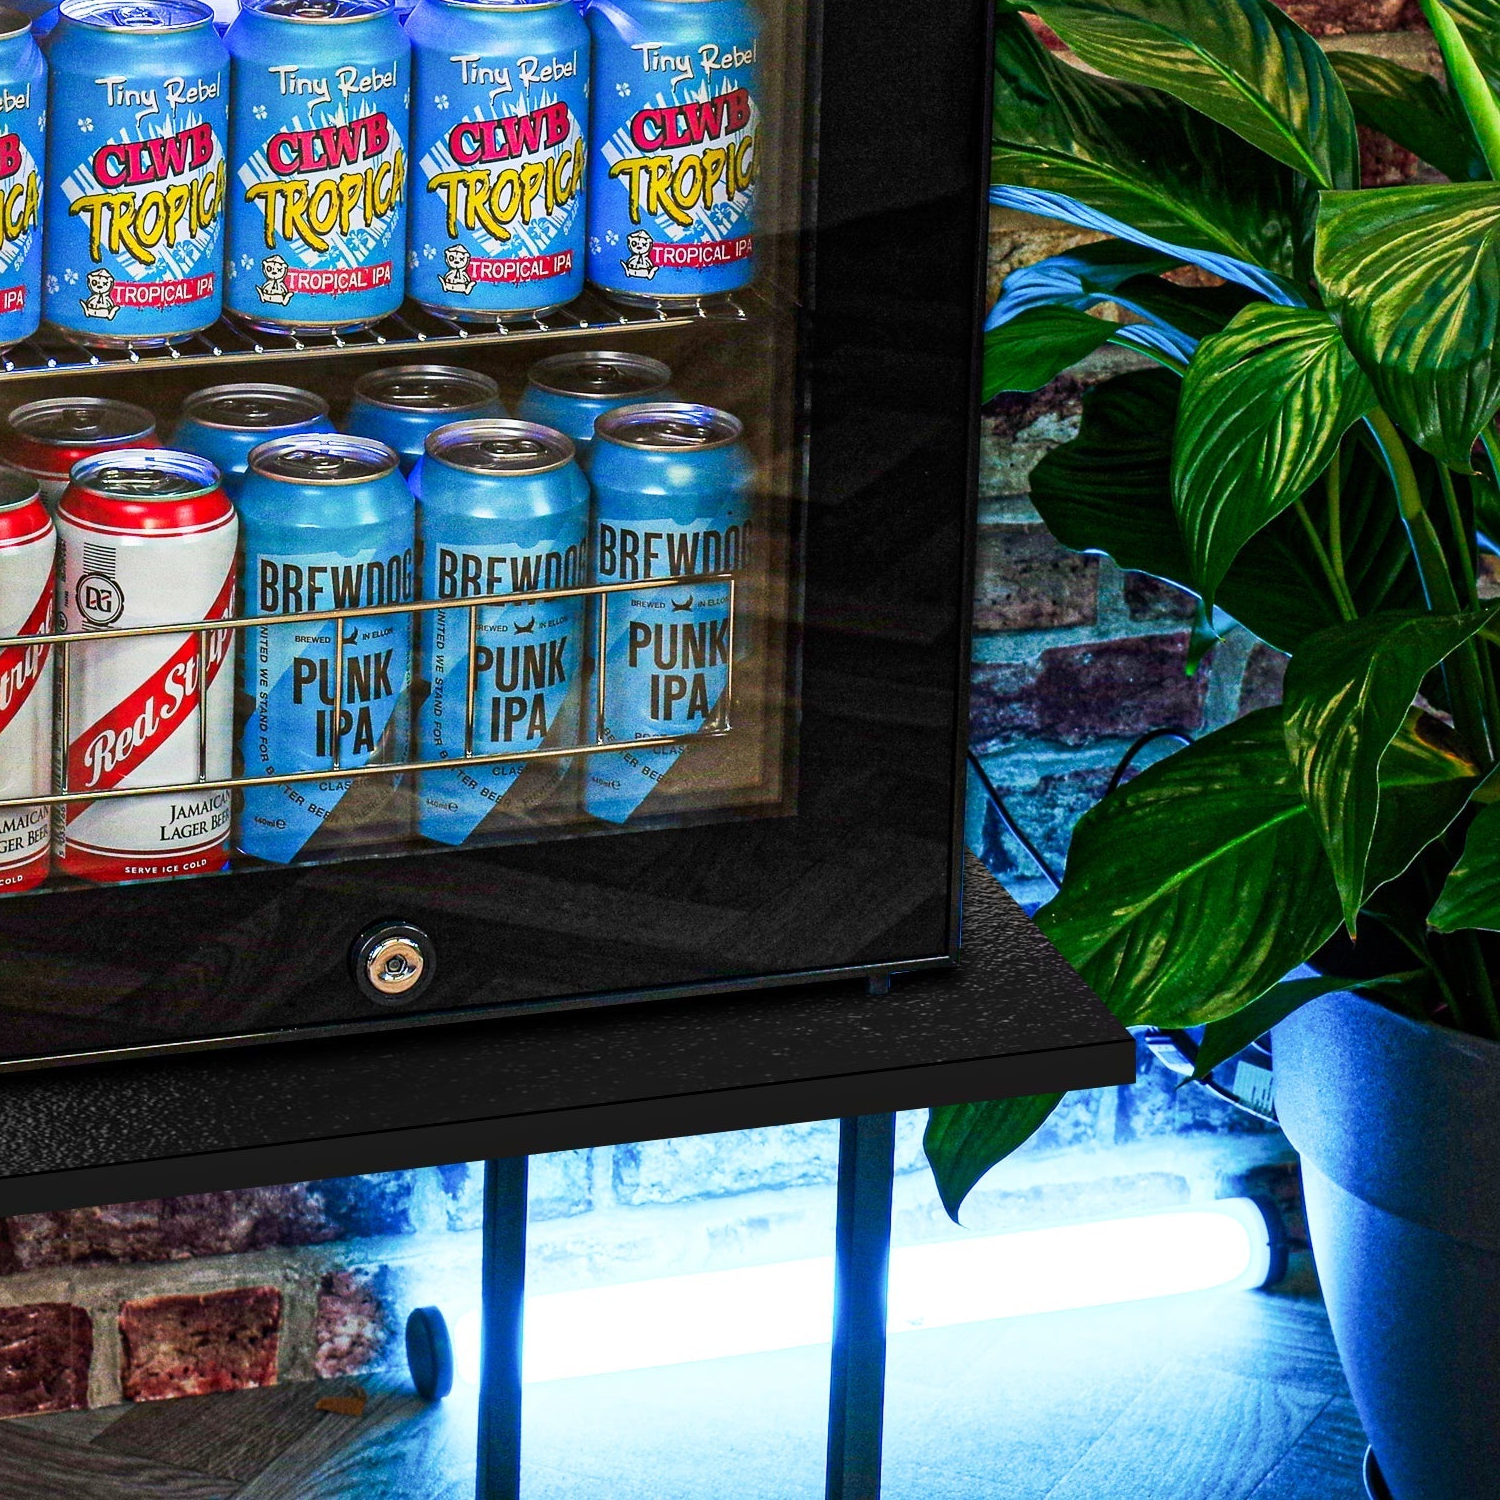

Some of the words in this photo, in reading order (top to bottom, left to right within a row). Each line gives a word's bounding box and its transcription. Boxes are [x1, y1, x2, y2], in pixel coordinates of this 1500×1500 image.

[450, 55, 513, 104] Tiny
[517, 51, 578, 96] Rebel
[631, 42, 693, 91] Tiny
[700, 38, 758, 83] Rebel
[95, 76, 160, 125] Tiny
[164, 72, 221, 116] Rebel
[268, 65, 332, 114] Tiny
[335, 60, 398, 104] Rebel
[449, 101, 571, 166] CLWB
[631, 88, 751, 152] CLWB
[94, 122, 214, 189] CLWB
[268, 112, 390, 175] CLWB
[470, 259, 549, 280] TROPICAL
[554, 254, 572, 273] IPA
[655, 244, 731, 264] TROPICAL
[736, 239, 754, 258] IPA
[115, 280, 193, 303] TROPICAL
[197, 278, 214, 299] IPA
[288, 269, 367, 289] TROPICAL
[372, 265, 391, 285] IPA
[4, 290, 23, 308] IPA
[260, 548, 413, 613] BREWDOG
[630, 599, 666, 609] BREWED
[697, 600, 706, 608] IN
[259, 625, 269, 663] NITED
[295, 635, 331, 644] BREWED
[628, 617, 728, 670] PUNK
[259, 668, 268, 688] WE
[293, 648, 393, 706] PUNK
[435, 655, 444, 673] WE
[473, 636, 568, 693] PUNK
[259, 692, 268, 732] STAND
[434, 677, 444, 717] STAND
[650, 673, 710, 721] IPA
[316, 706, 375, 757] IPA
[433, 721, 442, 746] FOR
[490, 693, 548, 742] IPA
[84, 696, 161, 788] Red
[259, 736, 269, 762] FOR
[160, 821, 208, 841] LAGER
[211, 807, 230, 830] BEER
[169, 789, 231, 825] JAMAICAN
[27, 823, 49, 847] BEER
[125, 866, 158, 874] SERVE
[162, 865, 179, 873] ICE
[183, 859, 207, 870] COLD
